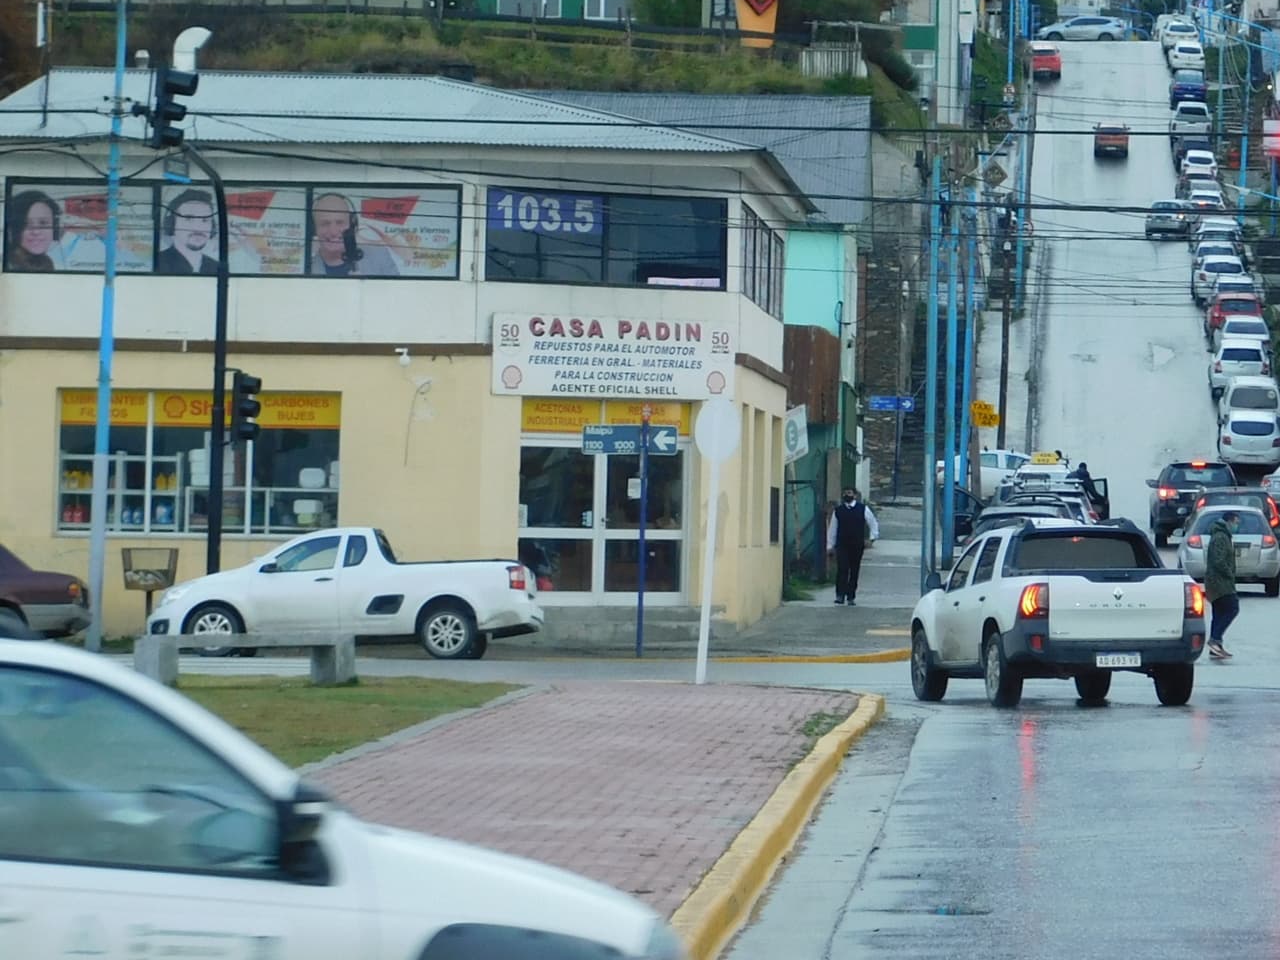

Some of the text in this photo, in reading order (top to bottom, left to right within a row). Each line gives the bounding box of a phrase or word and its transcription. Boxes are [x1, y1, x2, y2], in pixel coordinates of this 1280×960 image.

[498, 195, 595, 233] 103.5
[501, 324, 520, 338] 50
[529, 317, 702, 342] CASA PADIN
[711, 331, 729, 345] 50
[534, 341, 696, 356] REPUESTOS PARA EL AUTOMOTOR
[528, 355, 590, 366] FERRETERIA
[591, 357, 604, 367] EN
[641, 359, 703, 369] MATERIALES
[554, 370, 674, 382] PARA LA CONSTRUCCION
[551, 384, 679, 395] AGENTE OFICIAL SHELL
[264, 397, 329, 409] CARBONES
[80, 407, 128, 418] FILOS
[614, 440, 635, 450] 1000
